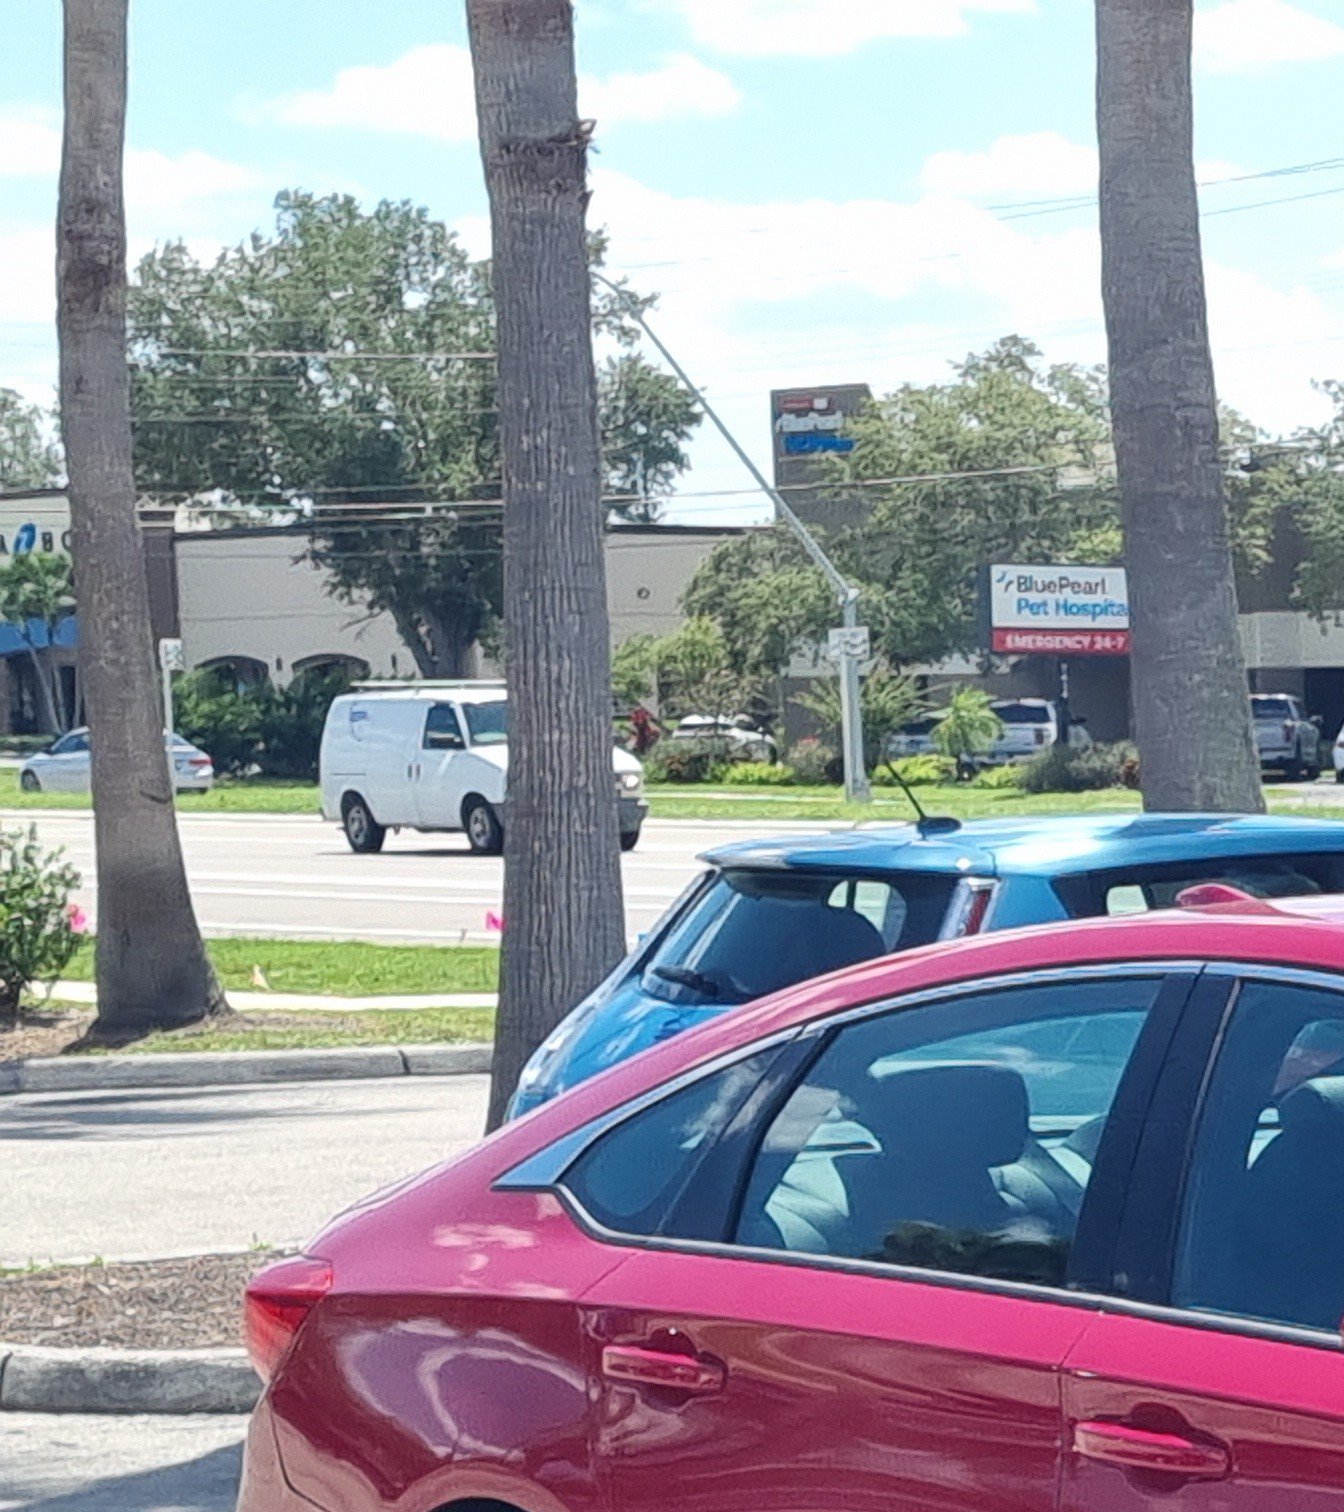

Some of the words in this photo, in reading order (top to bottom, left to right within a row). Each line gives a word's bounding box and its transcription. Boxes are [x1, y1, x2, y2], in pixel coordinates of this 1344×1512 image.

[1016, 573, 1106, 595] BluePearl
[1016, 597, 1050, 616] Pet
[1054, 598, 1129, 622] Hospita
